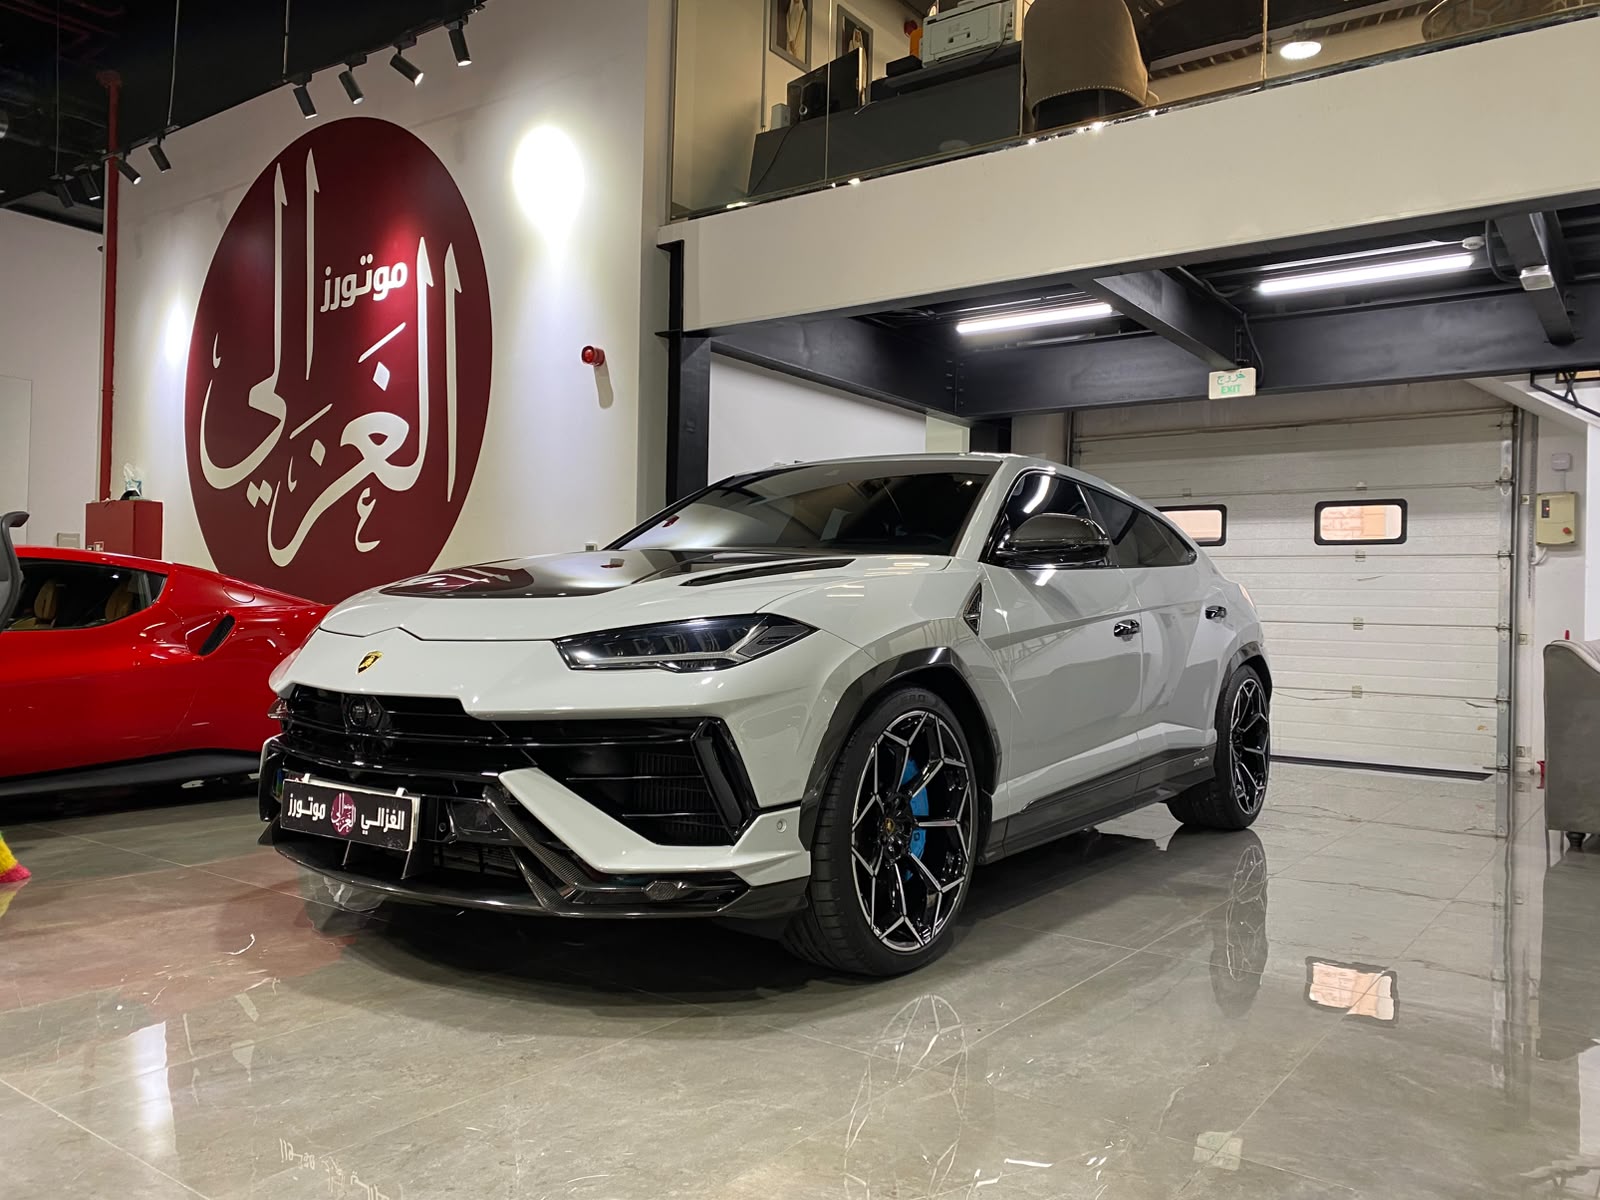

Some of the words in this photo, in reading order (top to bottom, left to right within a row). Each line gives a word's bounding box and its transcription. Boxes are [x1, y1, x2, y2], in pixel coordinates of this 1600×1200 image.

[319, 253, 409, 313] موتورز
[1217, 370, 1246, 385] خروج
[1221, 384, 1241, 394] EXIT
[287, 792, 327, 821] موتورز
[360, 806, 406, 835] الغزالي
